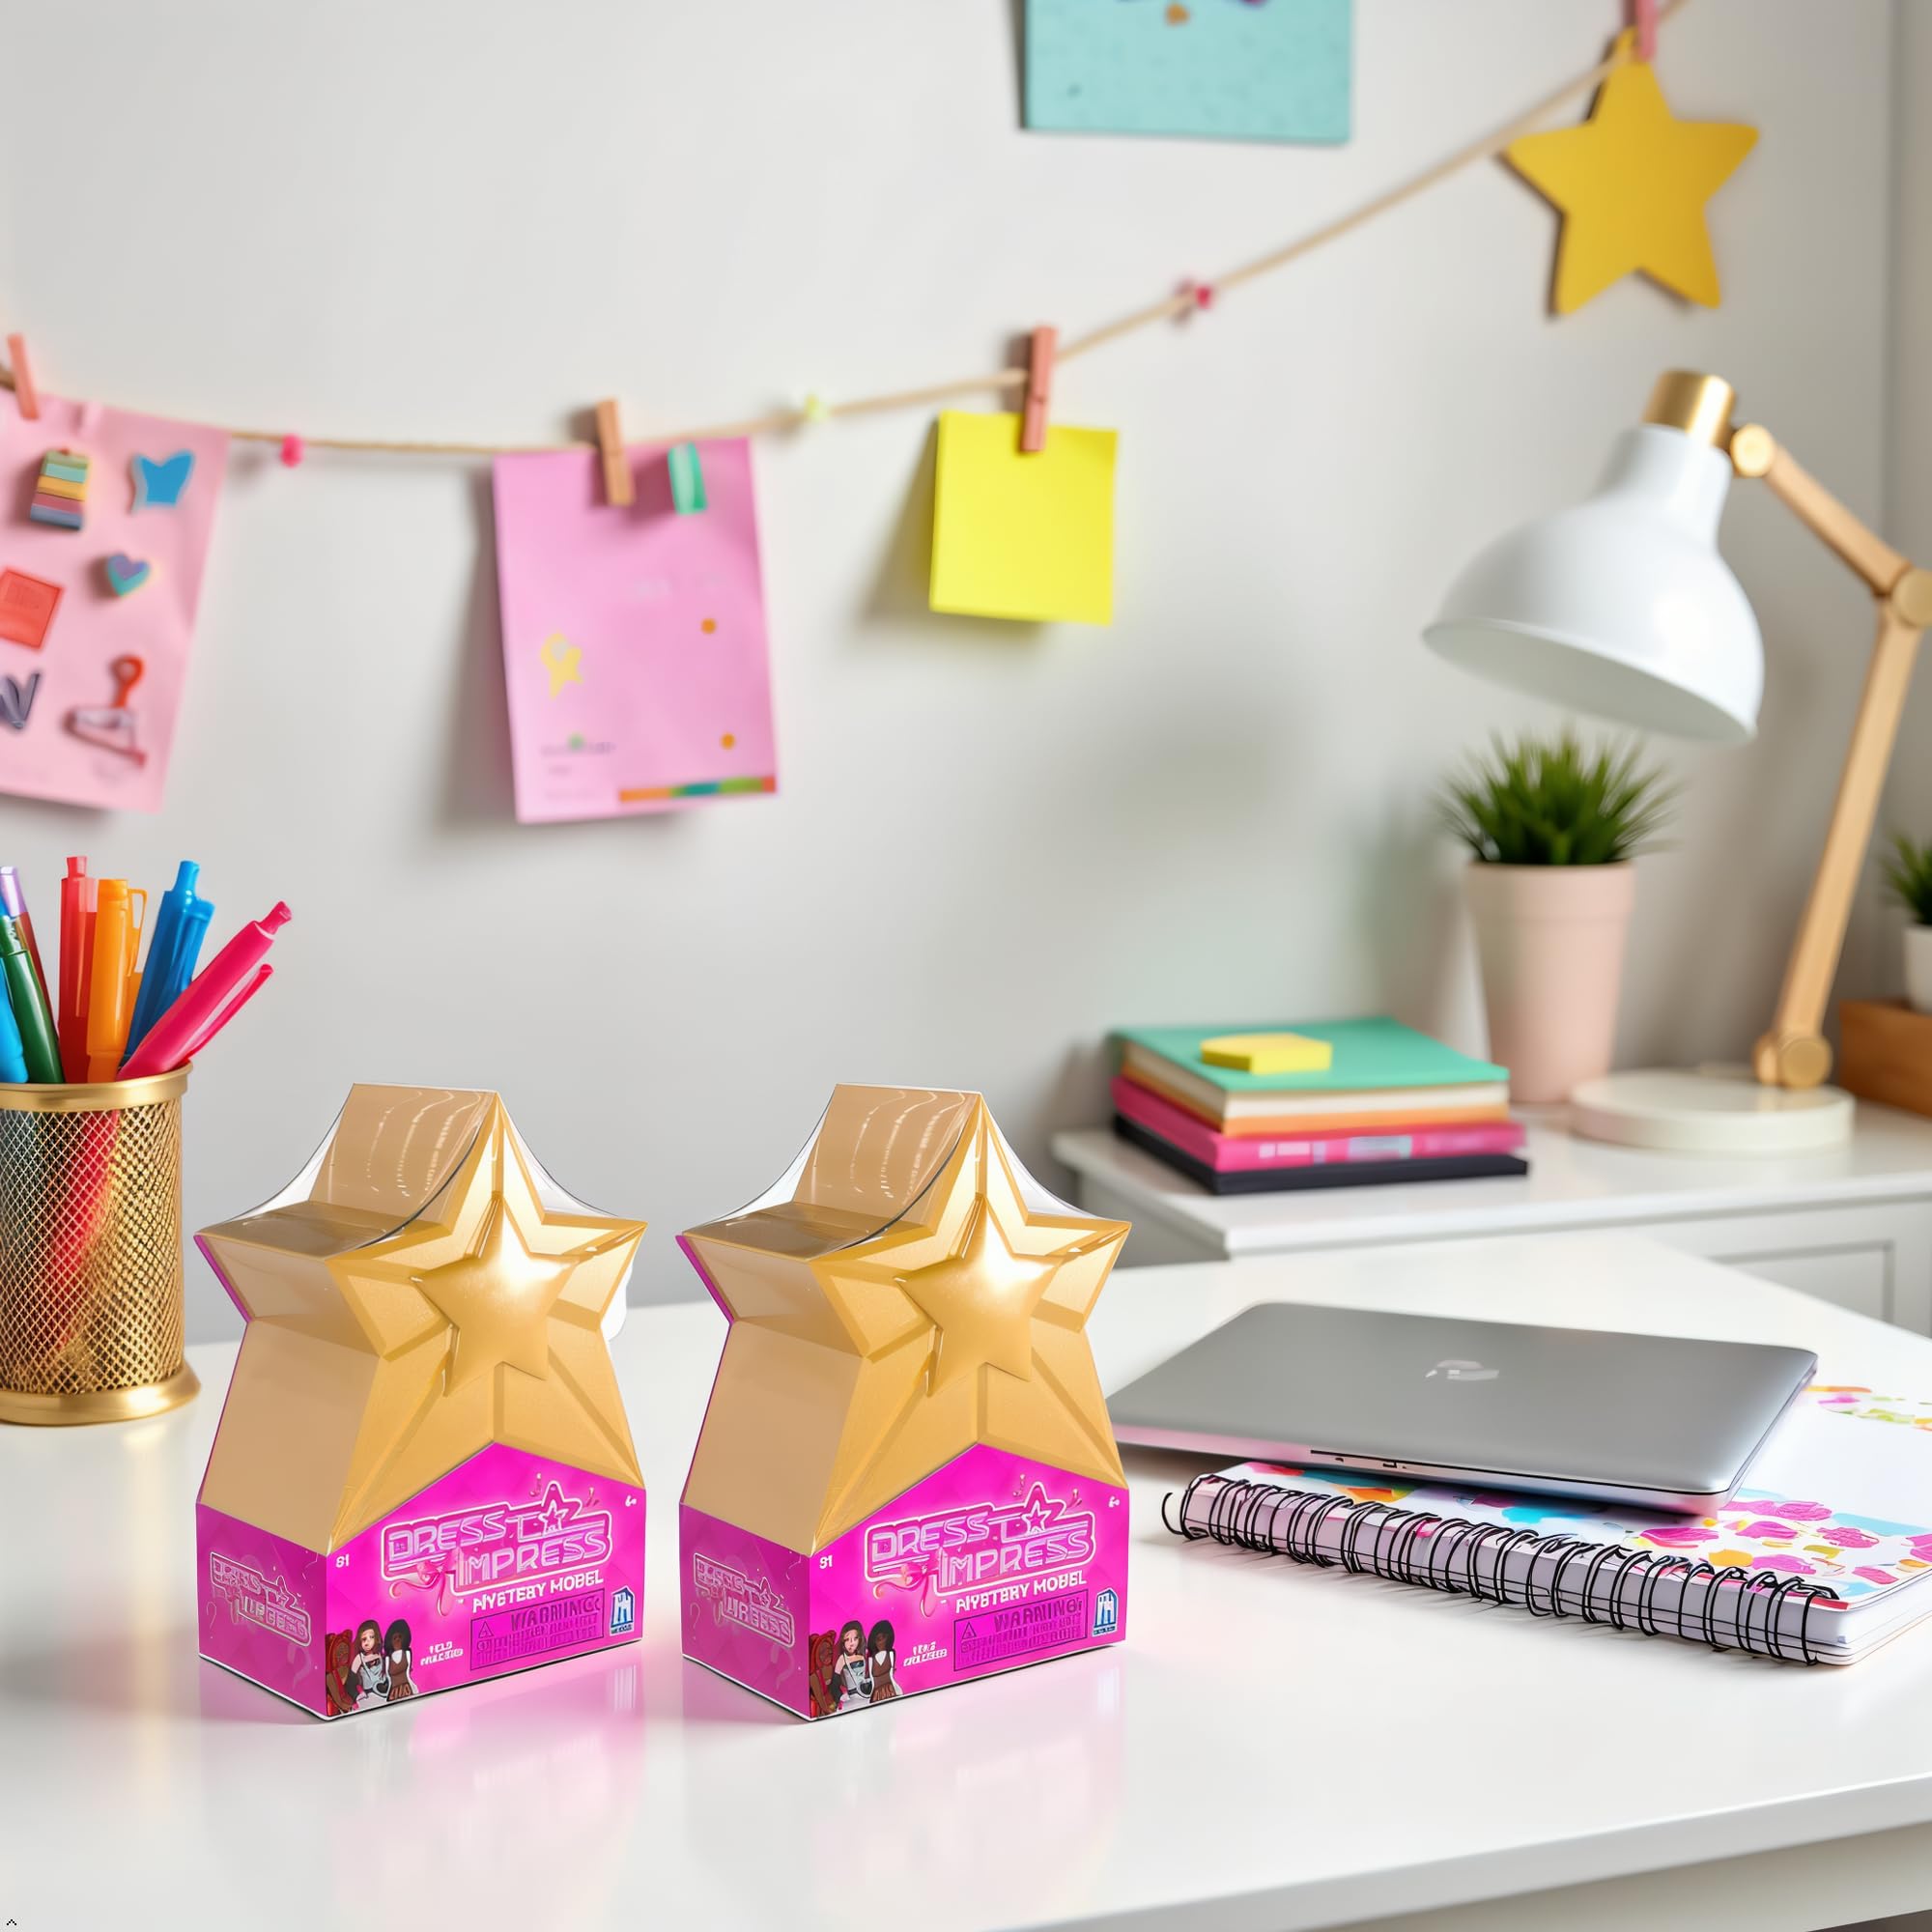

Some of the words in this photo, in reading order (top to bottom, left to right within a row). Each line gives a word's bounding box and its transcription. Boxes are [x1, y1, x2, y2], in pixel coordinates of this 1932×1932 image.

[388, 1510, 506, 1561] DRESS
[456, 1530, 607, 1586] IMPRESS
[871, 1511, 990, 1562] DRESS
[939, 1530, 1090, 1588] IMPRESS
